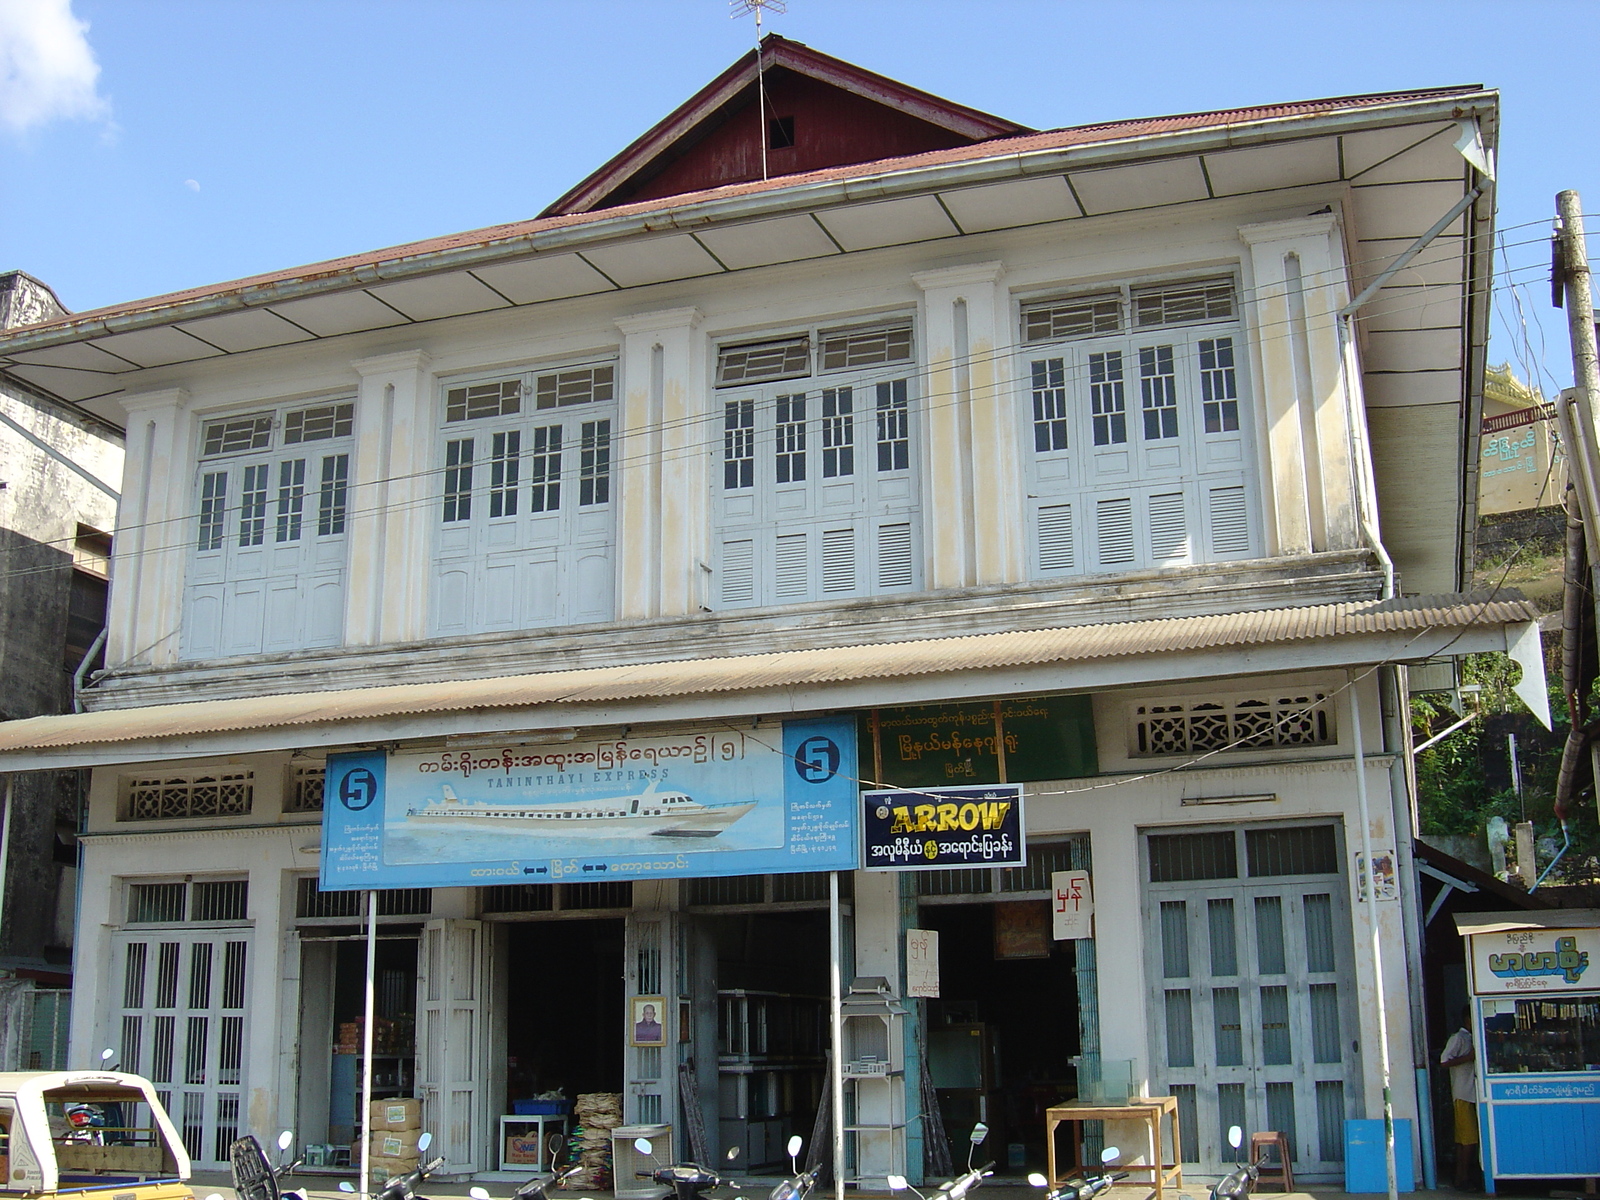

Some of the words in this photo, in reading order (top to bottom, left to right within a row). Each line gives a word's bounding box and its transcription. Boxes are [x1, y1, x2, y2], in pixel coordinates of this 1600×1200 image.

[487, 773, 583, 788] TANINTHAYI
[594, 768, 669, 783] EXPRESS
[890, 802, 1011, 834] ARROW
[470, 861, 519, 877] ထားဝယ်
[551, 859, 578, 878] မြိတ်
[611, 855, 689, 874] ကော့သောင်း
